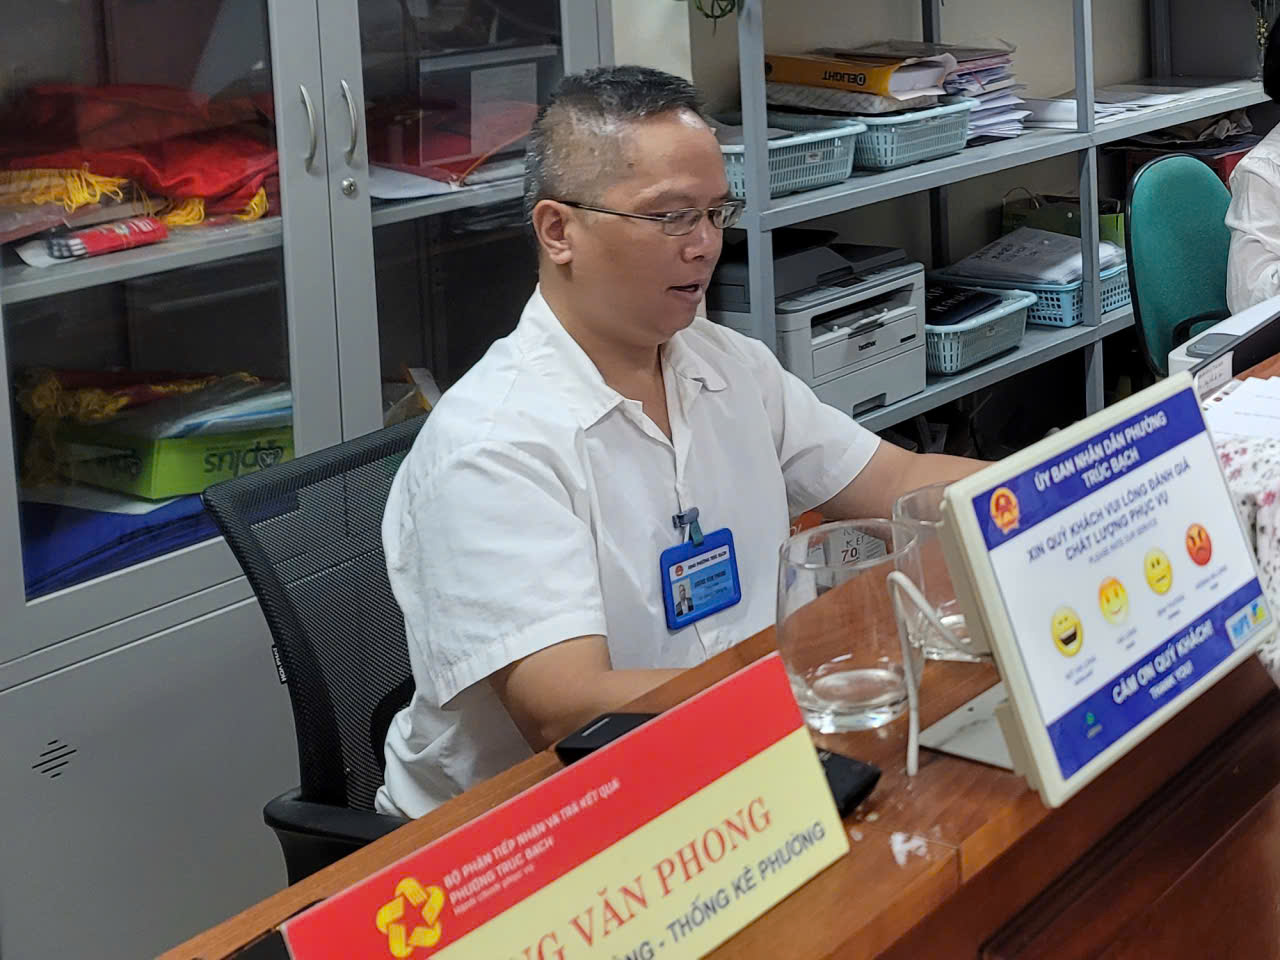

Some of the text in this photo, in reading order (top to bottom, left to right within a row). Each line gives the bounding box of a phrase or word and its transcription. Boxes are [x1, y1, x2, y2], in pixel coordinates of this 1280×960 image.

[569, 875, 650, 947] VĂN
[653, 796, 773, 898] PHONG
[666, 886, 731, 943] THỐNG
[759, 820, 828, 882] PHƯỜNG
